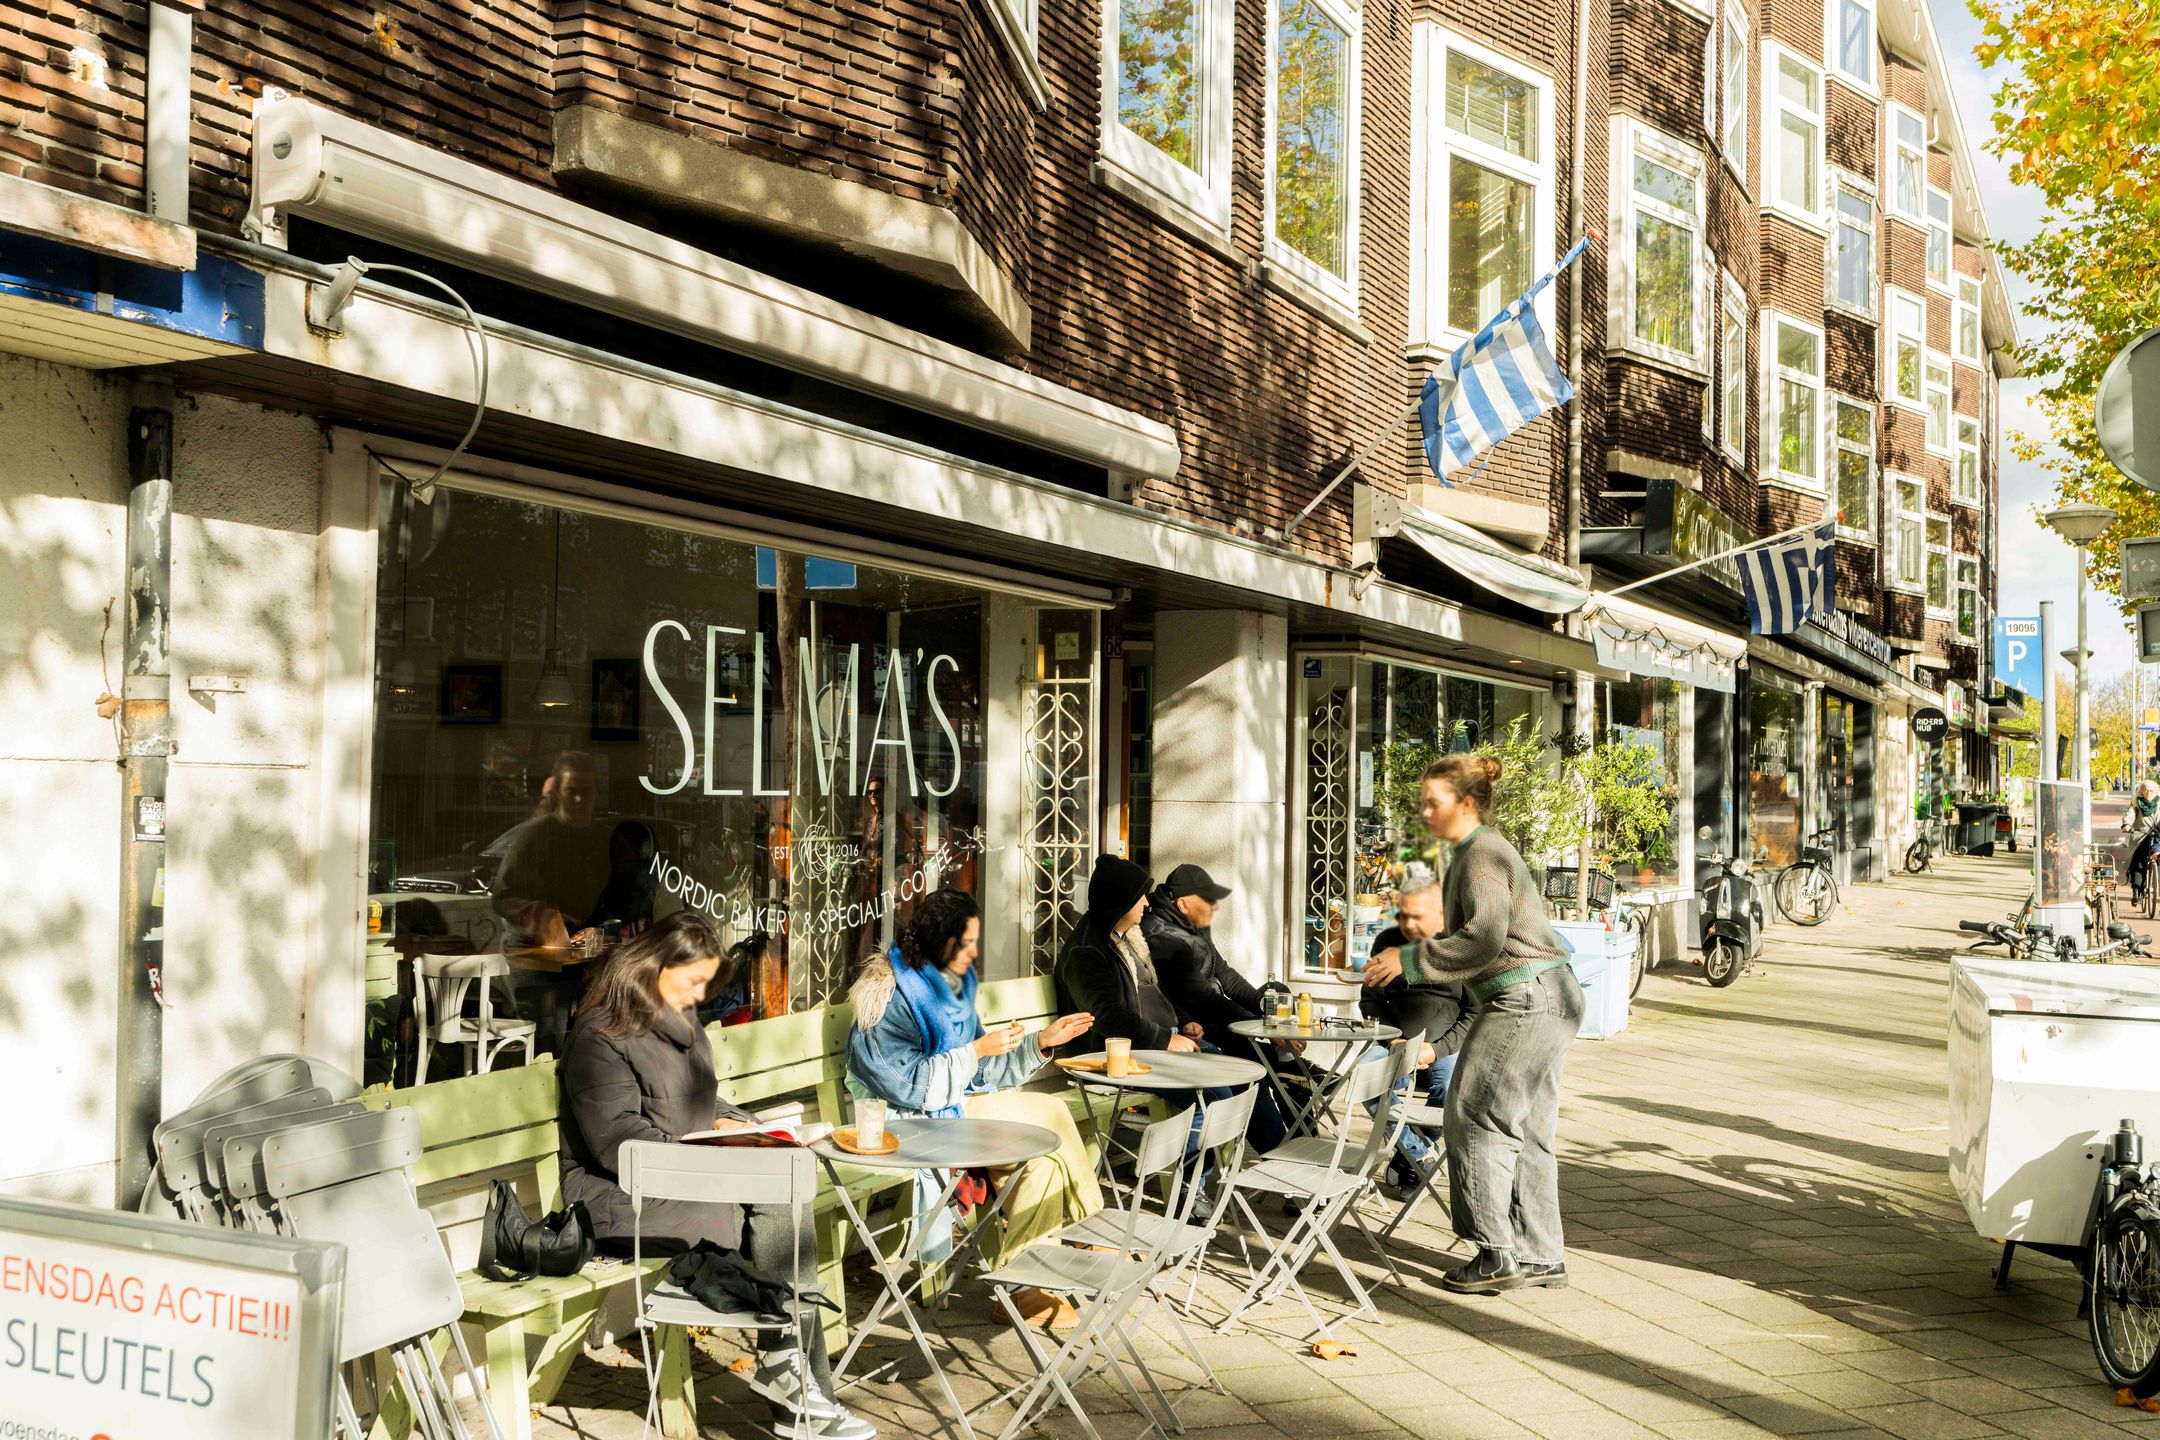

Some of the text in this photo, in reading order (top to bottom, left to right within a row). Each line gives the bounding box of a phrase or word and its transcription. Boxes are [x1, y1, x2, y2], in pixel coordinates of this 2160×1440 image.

[2007, 623, 2036, 633] 19096
[1105, 637, 1122, 656] 68
[2008, 640, 2027, 672] P
[638, 619, 962, 797] SELMA'S
[1916, 718, 1943, 726] RIDERS
[649, 842, 953, 935] NORDIC BAKERY & SPECIALTY COFFEE
[153, 1282, 291, 1342] ACTIE!!!
[5, 1318, 215, 1408] SLEUTELS
[0, 1420, 80, 1440] oensd
